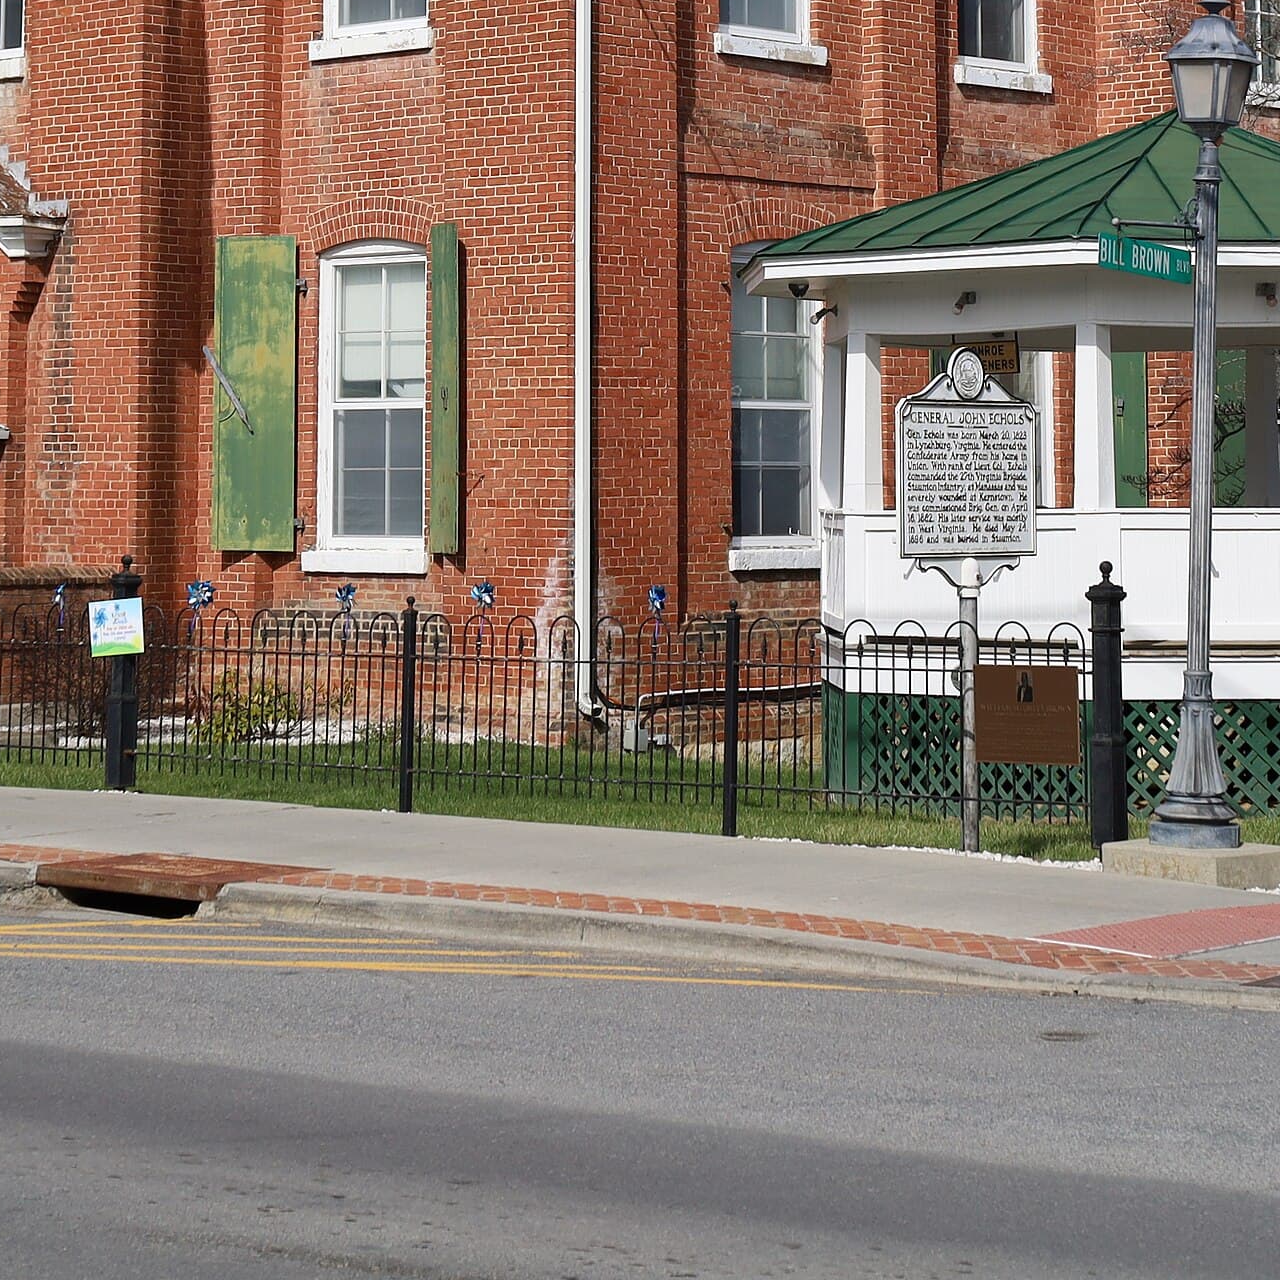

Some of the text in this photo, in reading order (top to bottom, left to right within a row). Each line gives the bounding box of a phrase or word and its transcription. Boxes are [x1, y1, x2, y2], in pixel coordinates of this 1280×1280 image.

[1100, 238, 1190, 275] BILL BROWN BLVD
[983, 360, 1015, 371] ENERS
[911, 412, 1025, 425] GENERAL JOHN ECHOLS
[924, 430, 944, 439] Echols
[961, 431, 977, 440] born
[980, 431, 999, 440] March
[908, 442, 914, 450] in
[983, 441, 991, 450] He
[993, 442, 1016, 450] entered
[1017, 442, 1027, 450] the
[907, 451, 1027, 461] Confederate Army from his home in
[931, 461, 947, 470] With
[948, 462, 964, 470] rank
[965, 462, 973, 470] of
[1008, 462, 1027, 471] Echols
[908, 472, 946, 480] commanded
[948, 472, 958, 480] the
[976, 472, 1001, 483] Virginia
[908, 482, 937, 491] Staunton
[968, 483, 974, 491] at
[976, 482, 1003, 491] Manassas
[1005, 482, 1016, 491] and
[908, 493, 935, 503] severely
[938, 493, 967, 501] wounded
[1019, 493, 1027, 501] He
[922, 503, 966, 512] commissioned
[1011, 503, 1028, 513] April
[938, 514, 949, 522] His
[951, 514, 966, 522] later
[969, 514, 990, 522] service
[1007, 513, 1027, 523] mostly
[909, 525, 915, 533] in
[919, 525, 934, 533] West
[972, 524, 981, 532] He
[985, 523, 998, 532] died
[1002, 523, 1015, 533] May
[927, 535, 939, 544] and
[942, 536, 954, 544] was
[958, 535, 978, 543] buried
[982, 535, 988, 543] in
